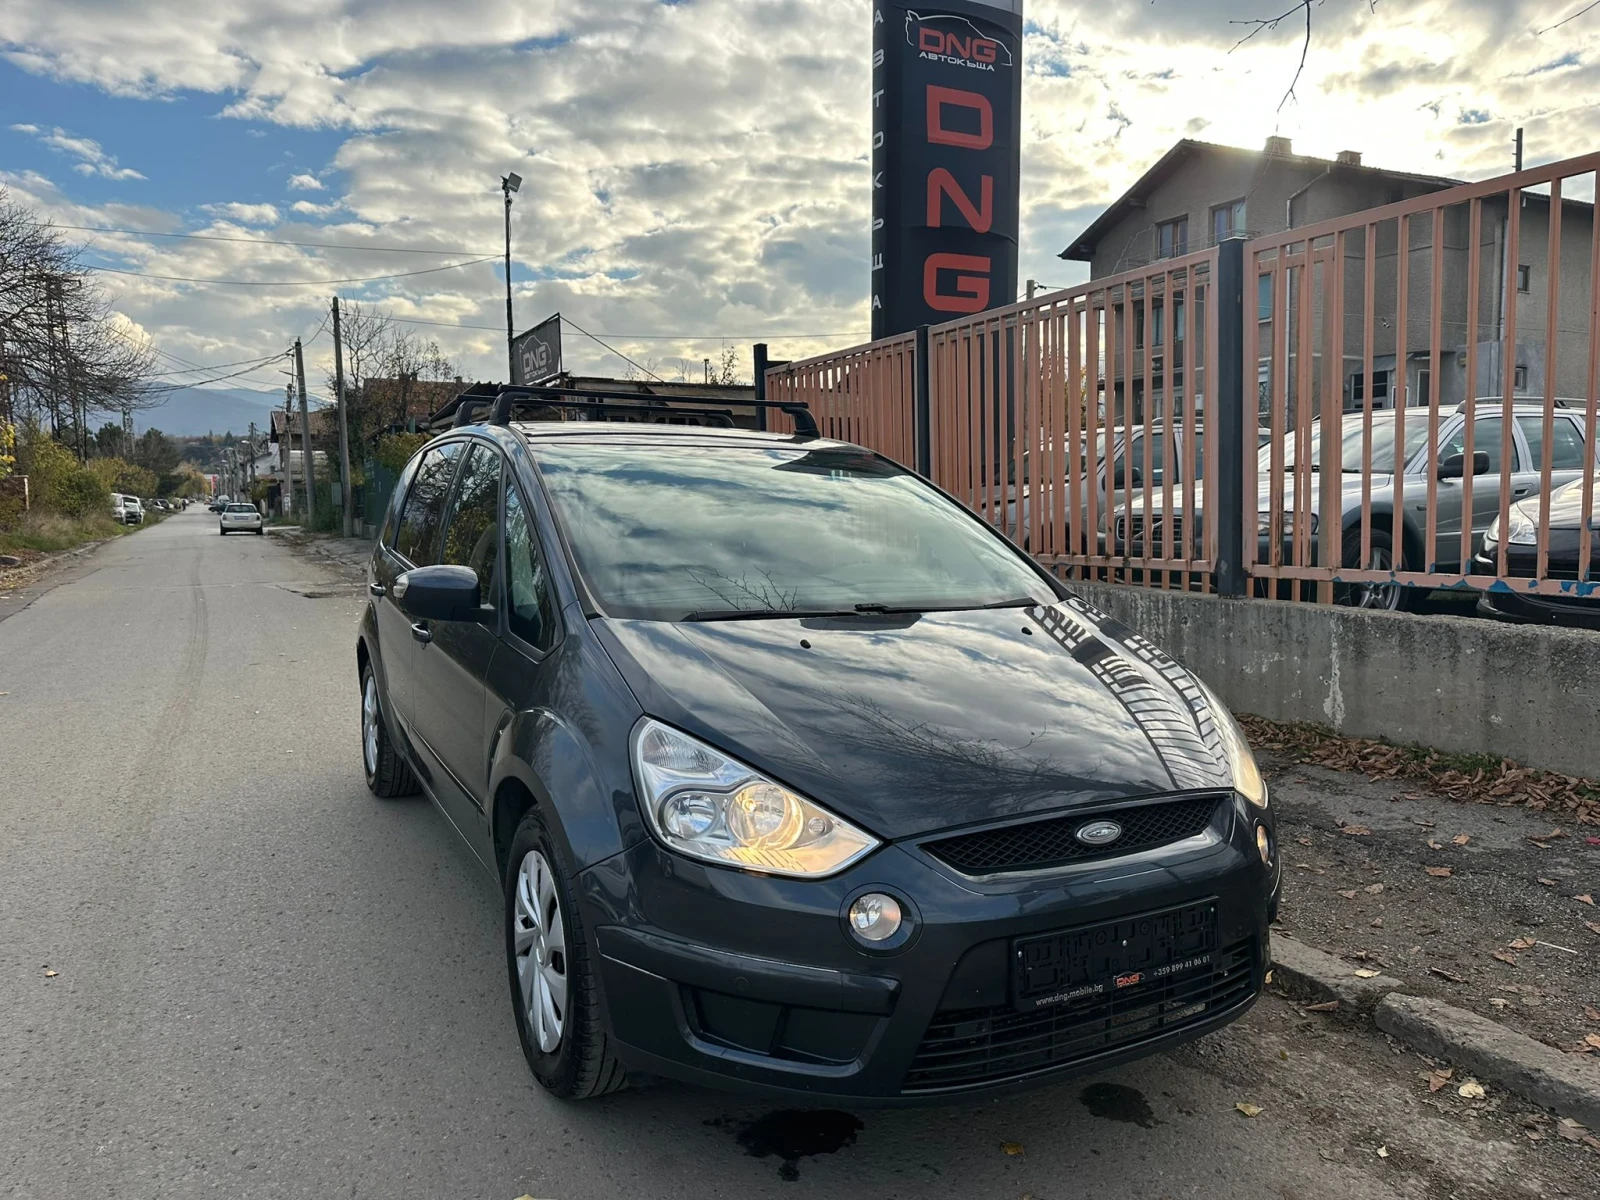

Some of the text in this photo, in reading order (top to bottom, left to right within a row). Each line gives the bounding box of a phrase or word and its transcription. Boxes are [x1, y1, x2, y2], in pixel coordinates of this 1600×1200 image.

[919, 27, 997, 63] DNG
[918, 51, 995, 72] АВТОКЪЩА
[923, 84, 993, 313] DNG
[523, 345, 547, 374] DNG
[1153, 955, 1210, 977] +359 899 41 06 01
[1116, 973, 1140, 987] DNG
[1035, 984, 1103, 1006] www.dng.mobile.bg
